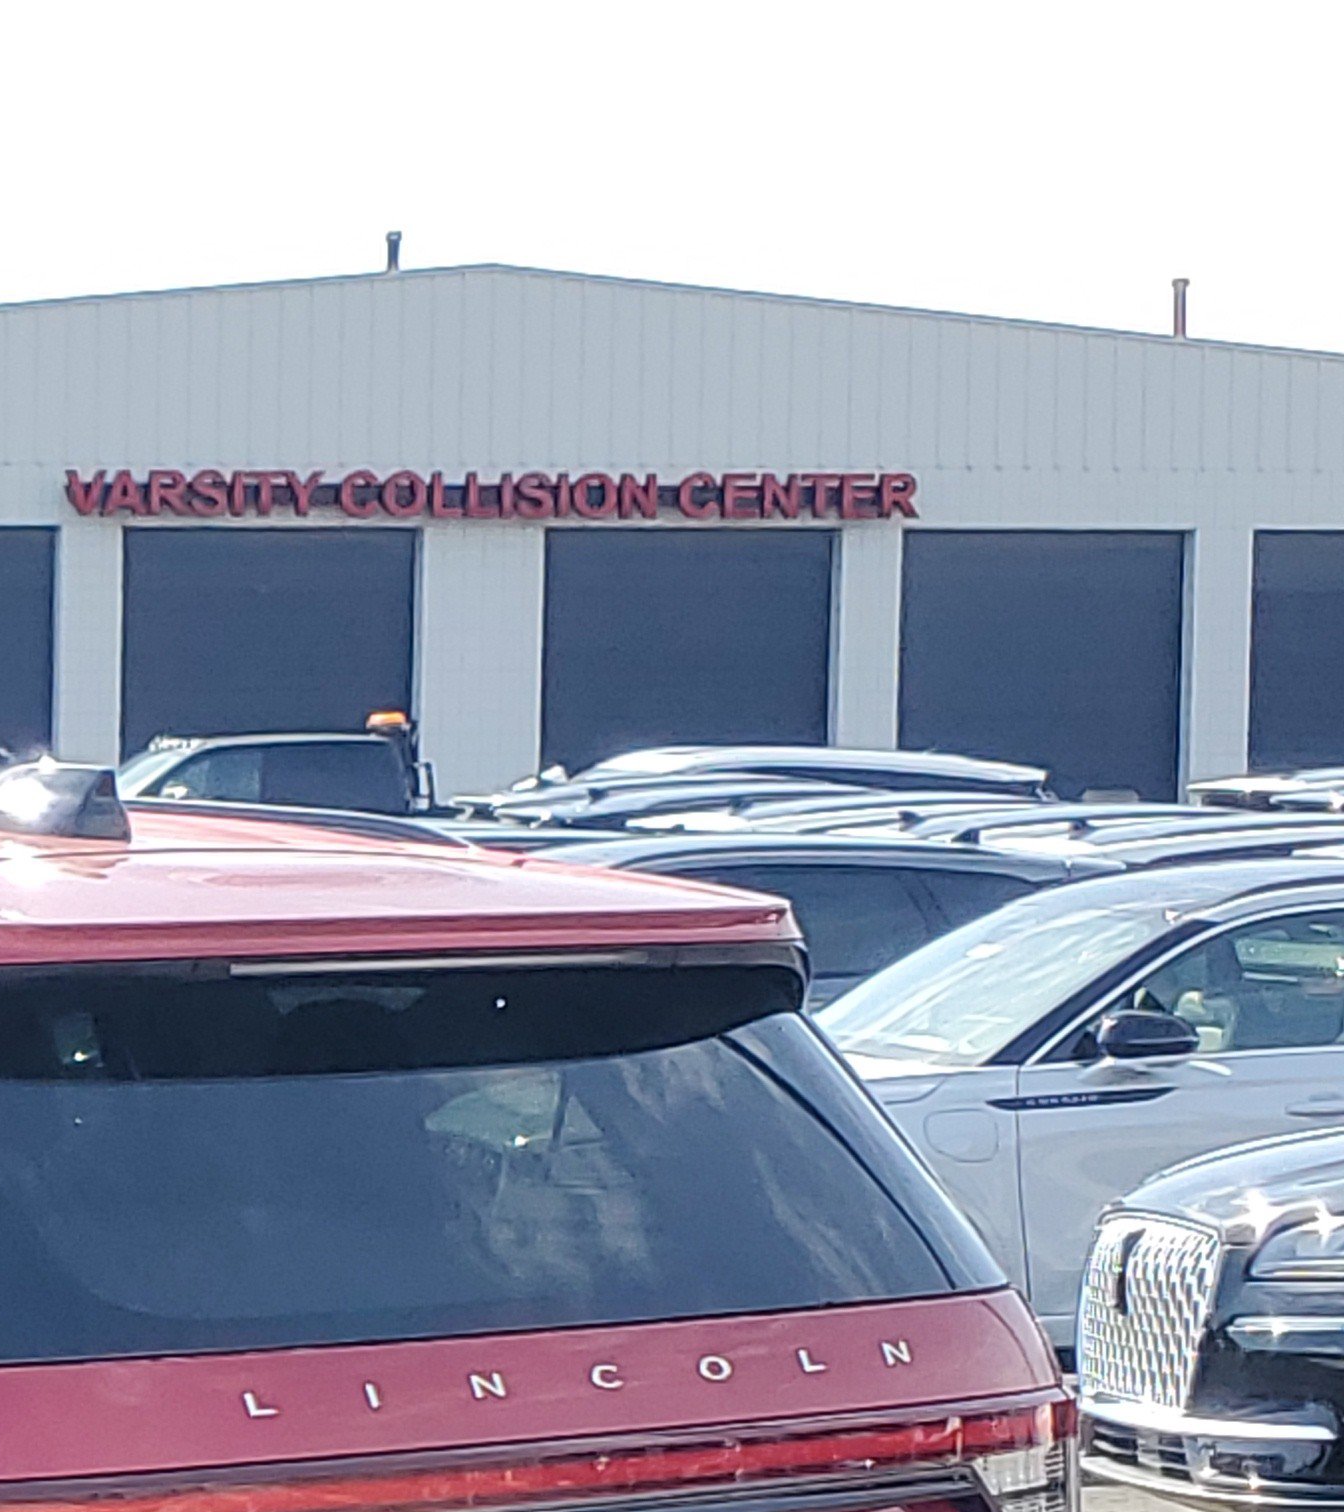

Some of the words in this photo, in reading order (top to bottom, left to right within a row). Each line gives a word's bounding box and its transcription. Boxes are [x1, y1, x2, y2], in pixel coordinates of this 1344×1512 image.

[65, 469, 325, 518] VARSITY
[339, 469, 658, 519] COLLISION
[678, 471, 920, 520] CENTER
[243, 1339, 912, 1418] LINCOLN
